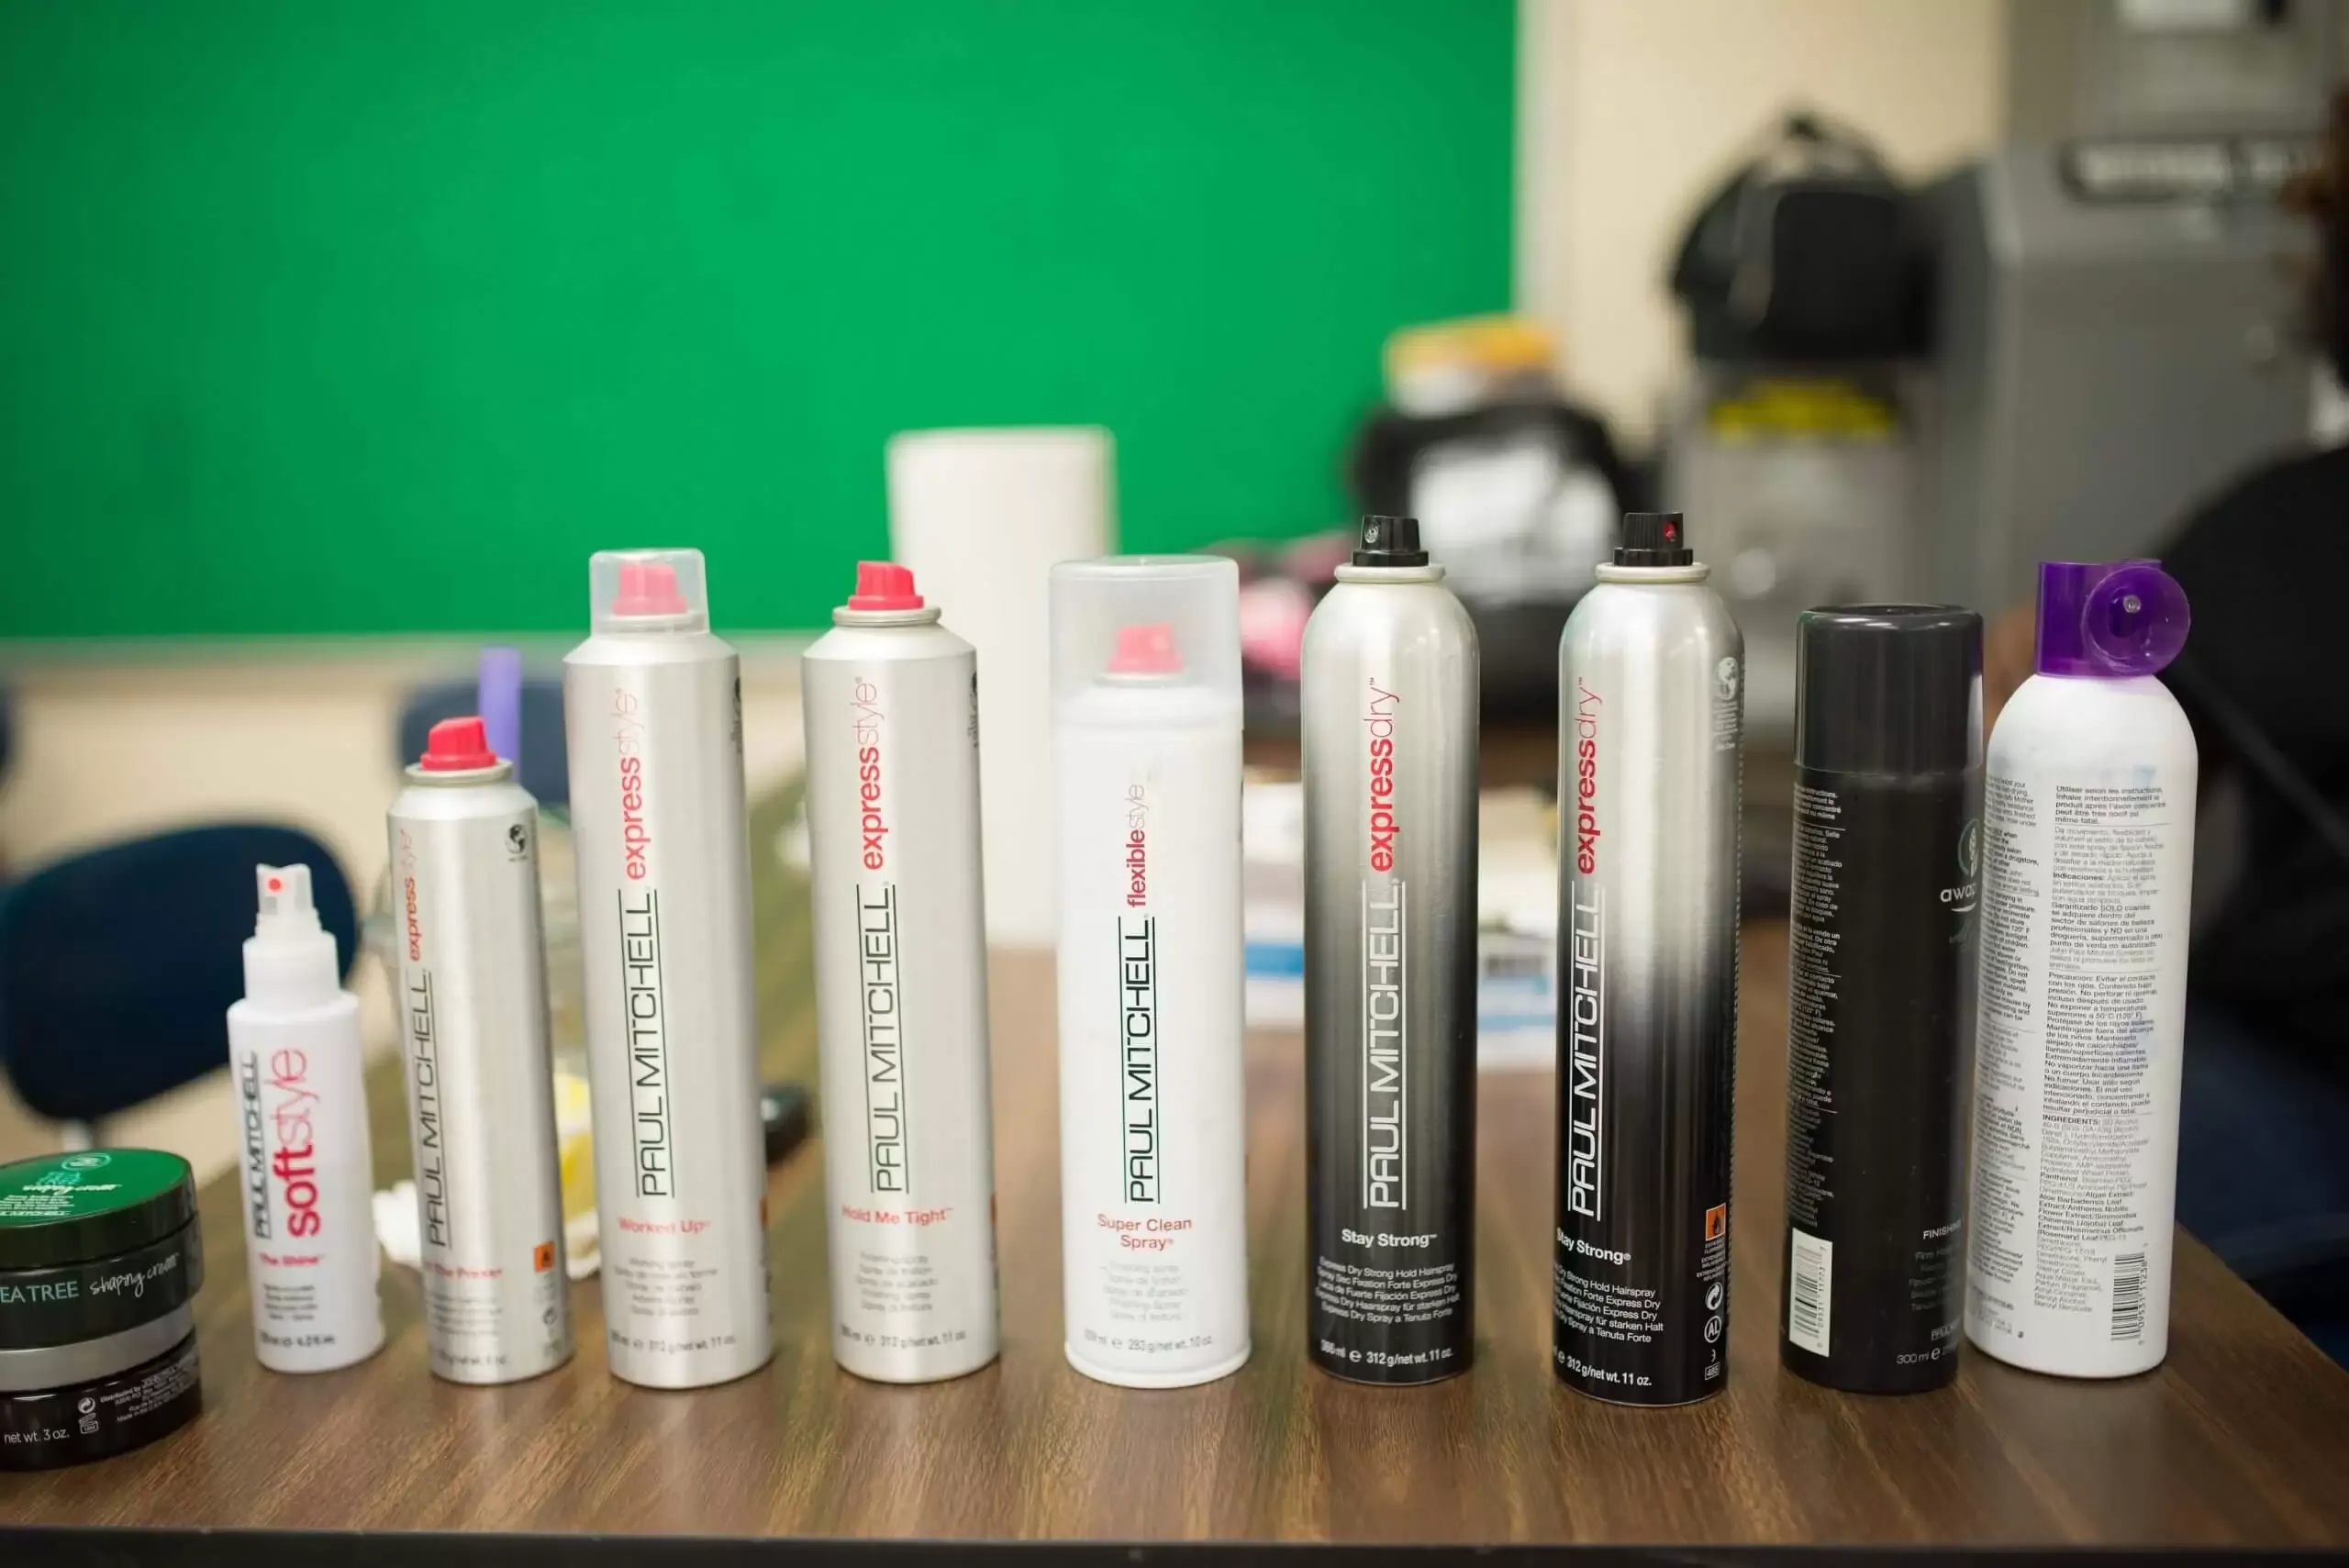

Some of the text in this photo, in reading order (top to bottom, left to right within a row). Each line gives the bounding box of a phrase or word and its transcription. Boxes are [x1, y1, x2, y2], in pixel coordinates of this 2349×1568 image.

[626, 892, 667, 1196] PAUL MITCHELL
[863, 887, 902, 1192] PAUL MITCHELL
[1369, 884, 1400, 1209] PAUL MITCHELL
[411, 969, 440, 1150] MITCHELL
[1125, 919, 1154, 1203] PAUL MITCHELL
[1572, 888, 1600, 1218] PAUL MITCHELL
[271, 1049, 321, 1238] softstyle
[423, 1156, 447, 1248] PAUL
[875, 1210, 900, 1224] Me
[905, 1209, 947, 1226] Tight
[1097, 1214, 1192, 1231] Super Clean
[1120, 1235, 1166, 1251] Spray
[1341, 1228, 1430, 1249] Stay Strong
[1576, 1240, 1623, 1265] Strong
[1396, 1268, 1418, 1278] Hold
[0, 1281, 79, 1304] EA TREE
[1387, 1280, 1411, 1290] Forte
[1590, 1280, 1610, 1293] Hold
[1612, 1284, 1656, 1299] Hairspray
[1583, 1289, 1661, 1311] Forte Express Dry
[1603, 1306, 1639, 1320] Express
[1641, 1311, 1658, 1322] Dry
[1597, 1327, 1625, 1341] Tenuta
[1627, 1332, 1652, 1343] Forte
[1609, 1319, 1642, 1331] starken
[1644, 1322, 1664, 1332] Halt
[1708, 1320, 1720, 1338] AL
[1366, 1351, 1386, 1365] 312
[1386, 1353, 1413, 1367] g/net
[1430, 1349, 1440, 1362] 11
[1896, 1353, 1918, 1365] 300
[1567, 1355, 1582, 1373] 312
[1581, 1364, 1605, 1381] g/net
[1606, 1372, 1620, 1384] wt.
[1622, 1373, 1634, 1385] 11
[1637, 1376, 1652, 1386] oz.
[4, 1431, 21, 1444] net
[43, 1428, 51, 1440] 3
[52, 1427, 70, 1440] oz.
